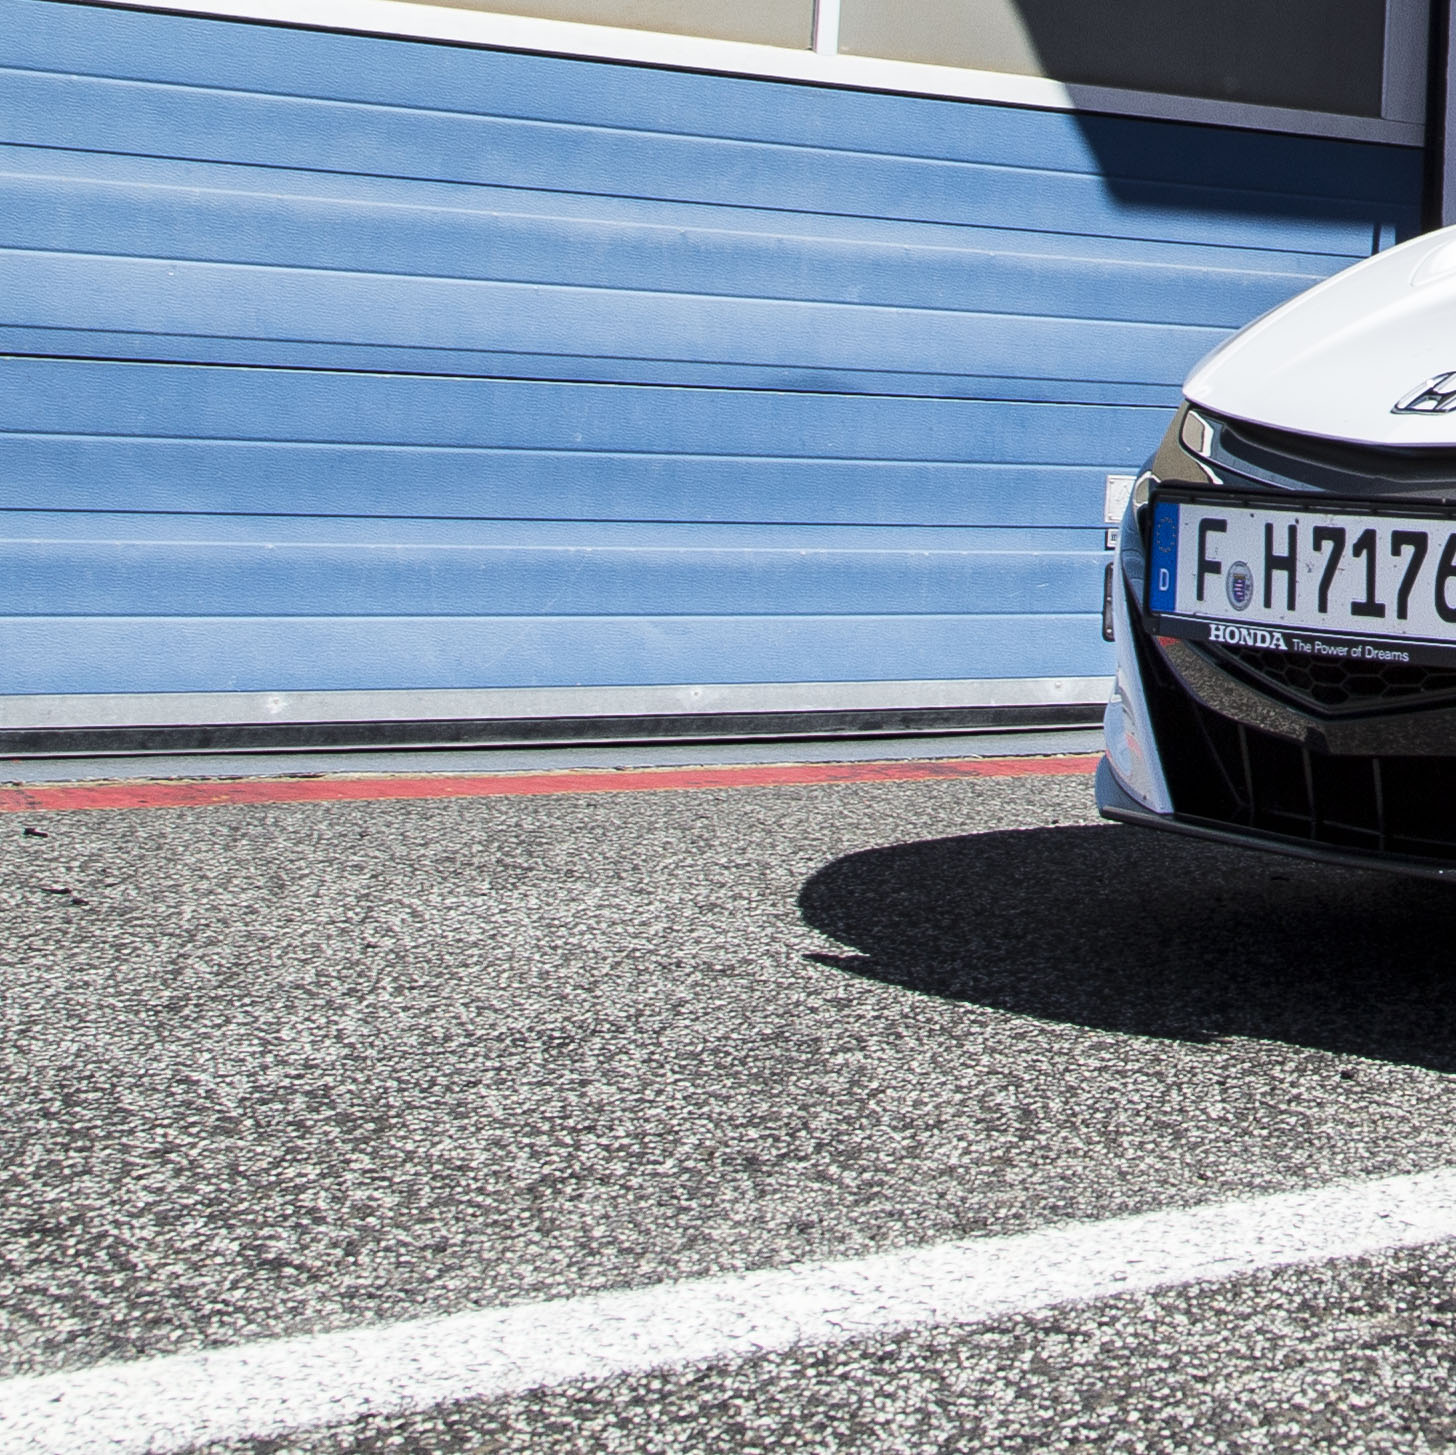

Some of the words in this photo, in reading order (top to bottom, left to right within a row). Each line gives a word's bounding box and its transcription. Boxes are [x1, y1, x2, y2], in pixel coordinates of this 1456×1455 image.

[1196, 518, 1227, 602] F
[1159, 568, 1170, 592] D
[1209, 624, 1288, 651] HONDA
[1292, 639, 1312, 653] The
[1314, 641, 1348, 657] Power
[1351, 645, 1362, 657] of
[1365, 645, 1410, 663] Dreams
